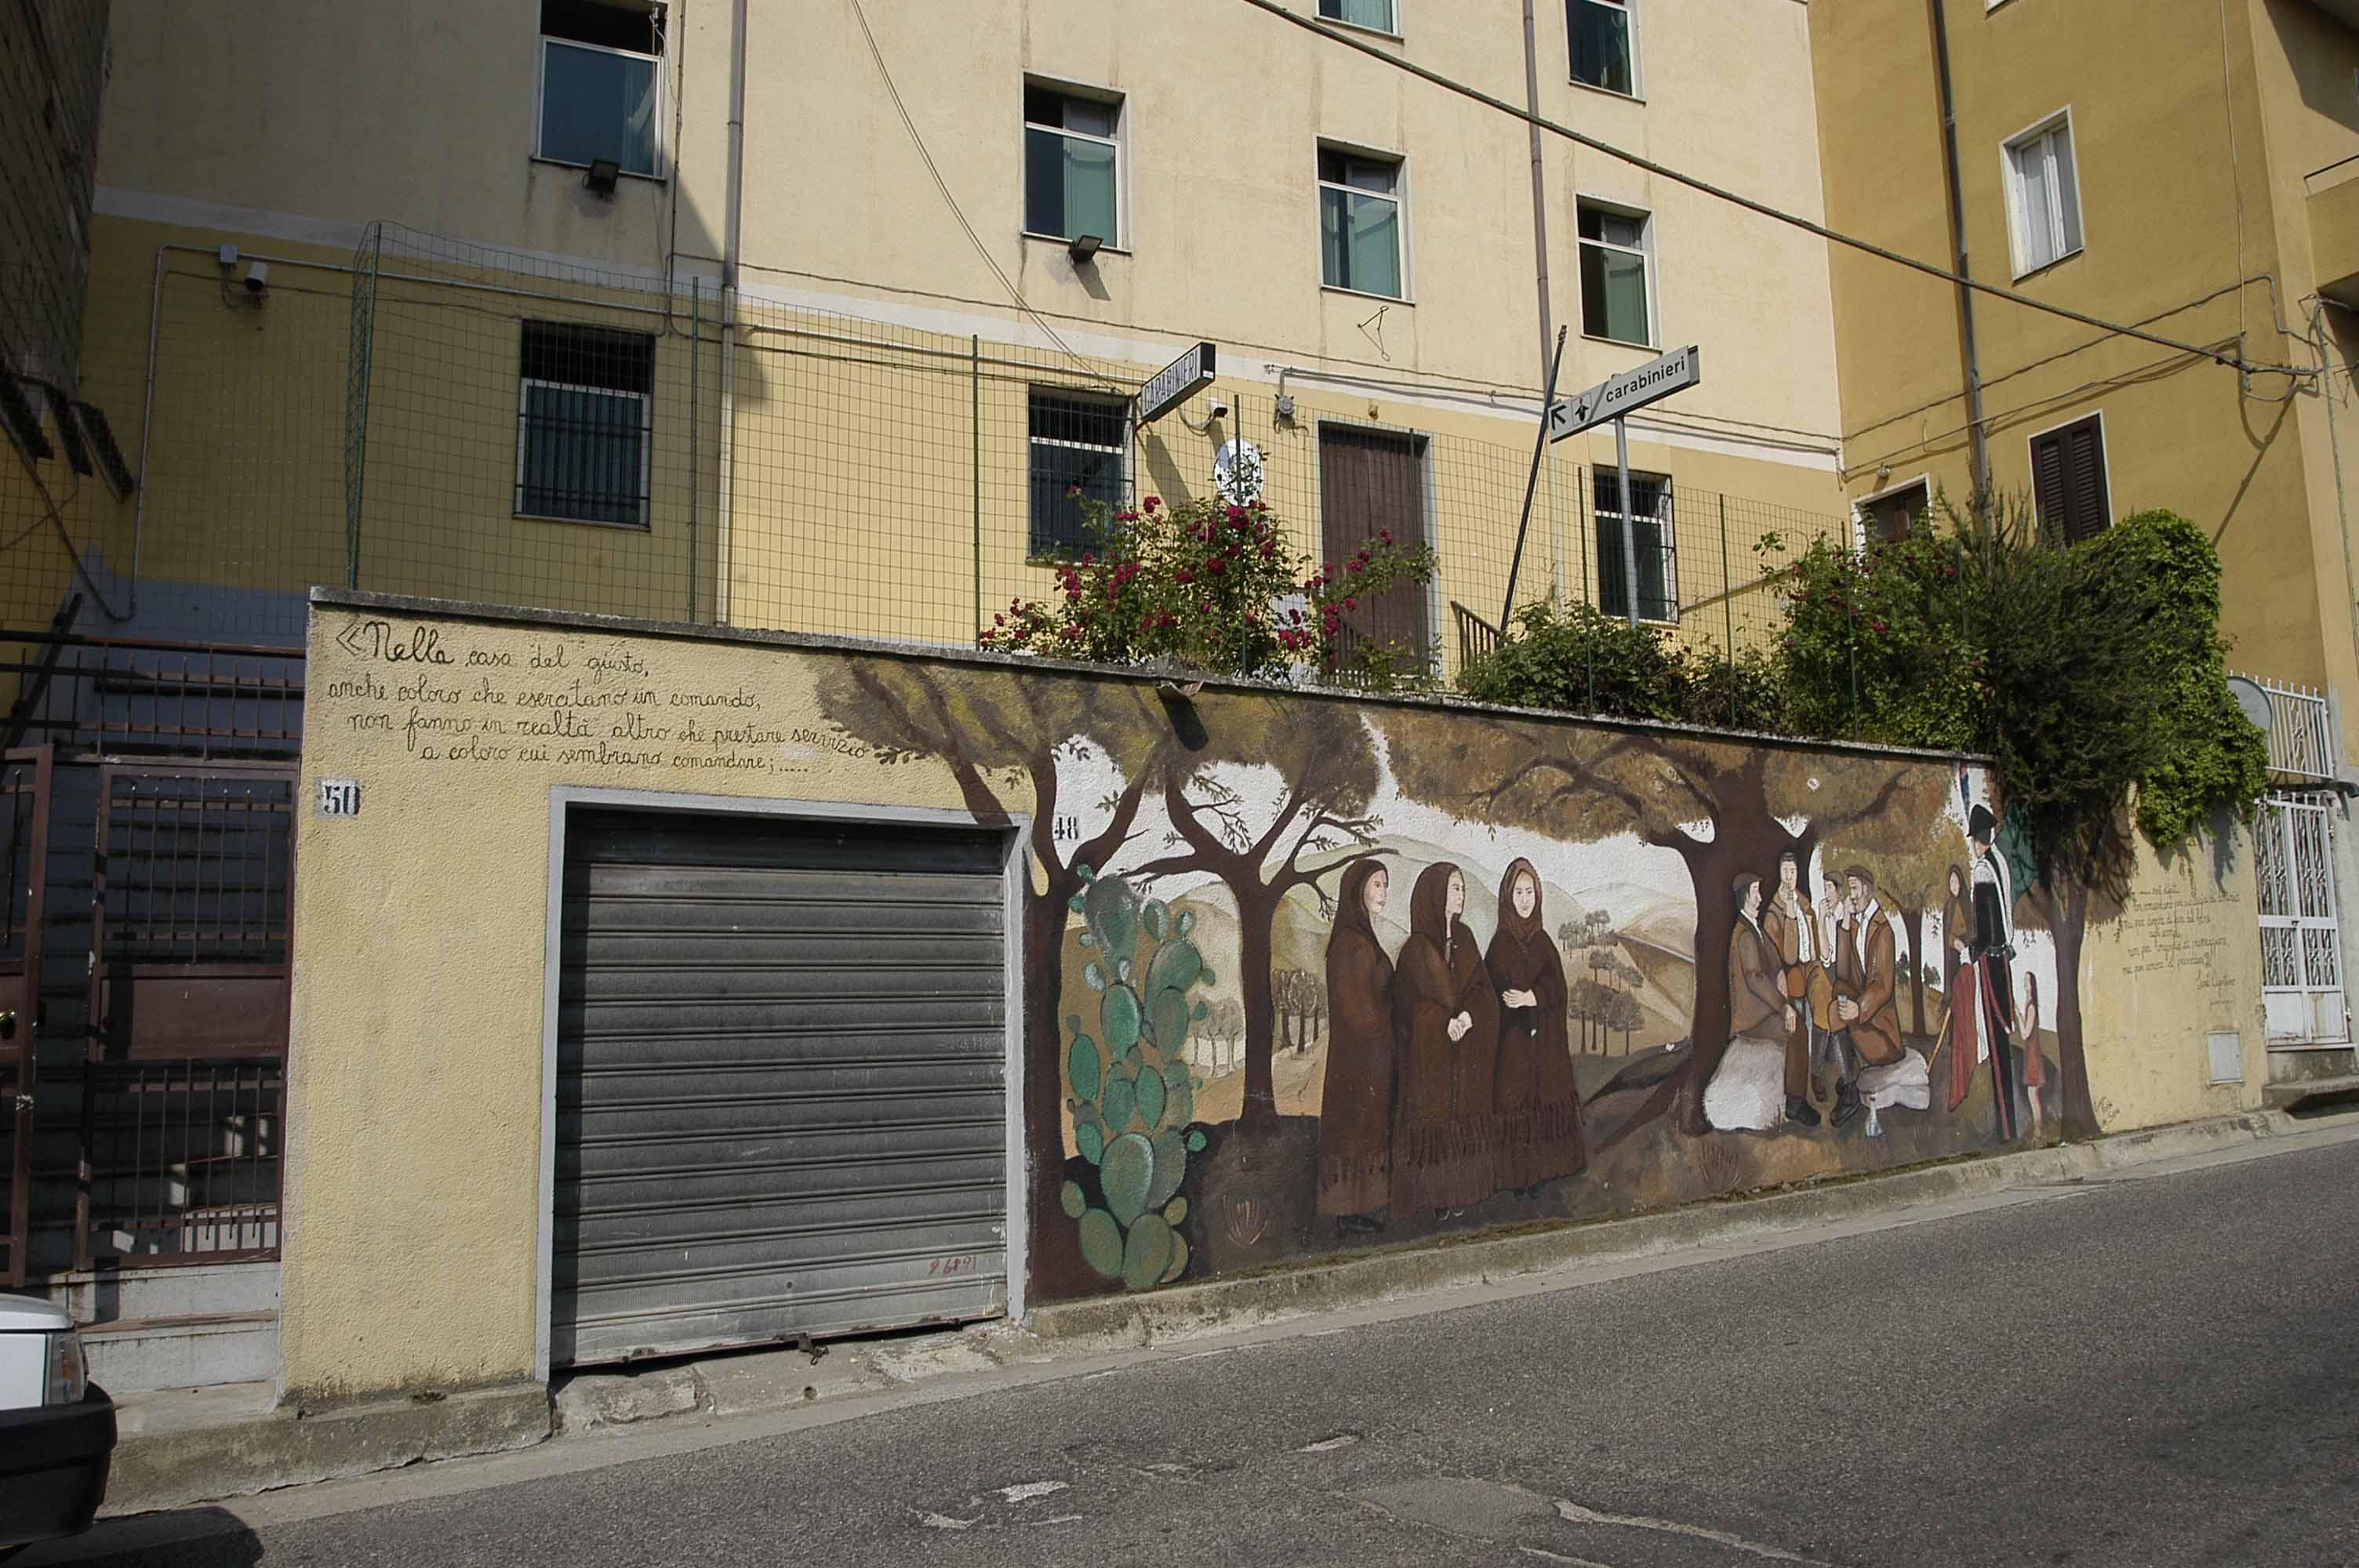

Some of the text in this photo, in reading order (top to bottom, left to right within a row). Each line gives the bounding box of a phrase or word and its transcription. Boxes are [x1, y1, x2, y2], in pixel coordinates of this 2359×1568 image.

[1144, 350, 1198, 412] CARABINIERI
[1606, 356, 1685, 403] carabinieri
[465, 650, 514, 667] casa
[530, 644, 570, 668] del
[584, 652, 649, 684] giusto,
[328, 673, 761, 710] anche coloro che esercitano un comando,
[347, 706, 868, 759] non fanno in realtà altro che prestare servizio
[420, 746, 441, 760] a
[449, 735, 509, 763] coloro
[518, 745, 550, 762] cui
[557, 741, 662, 765] sembrano
[323, 785, 361, 816] 50
[1054, 816, 1079, 840] 48
